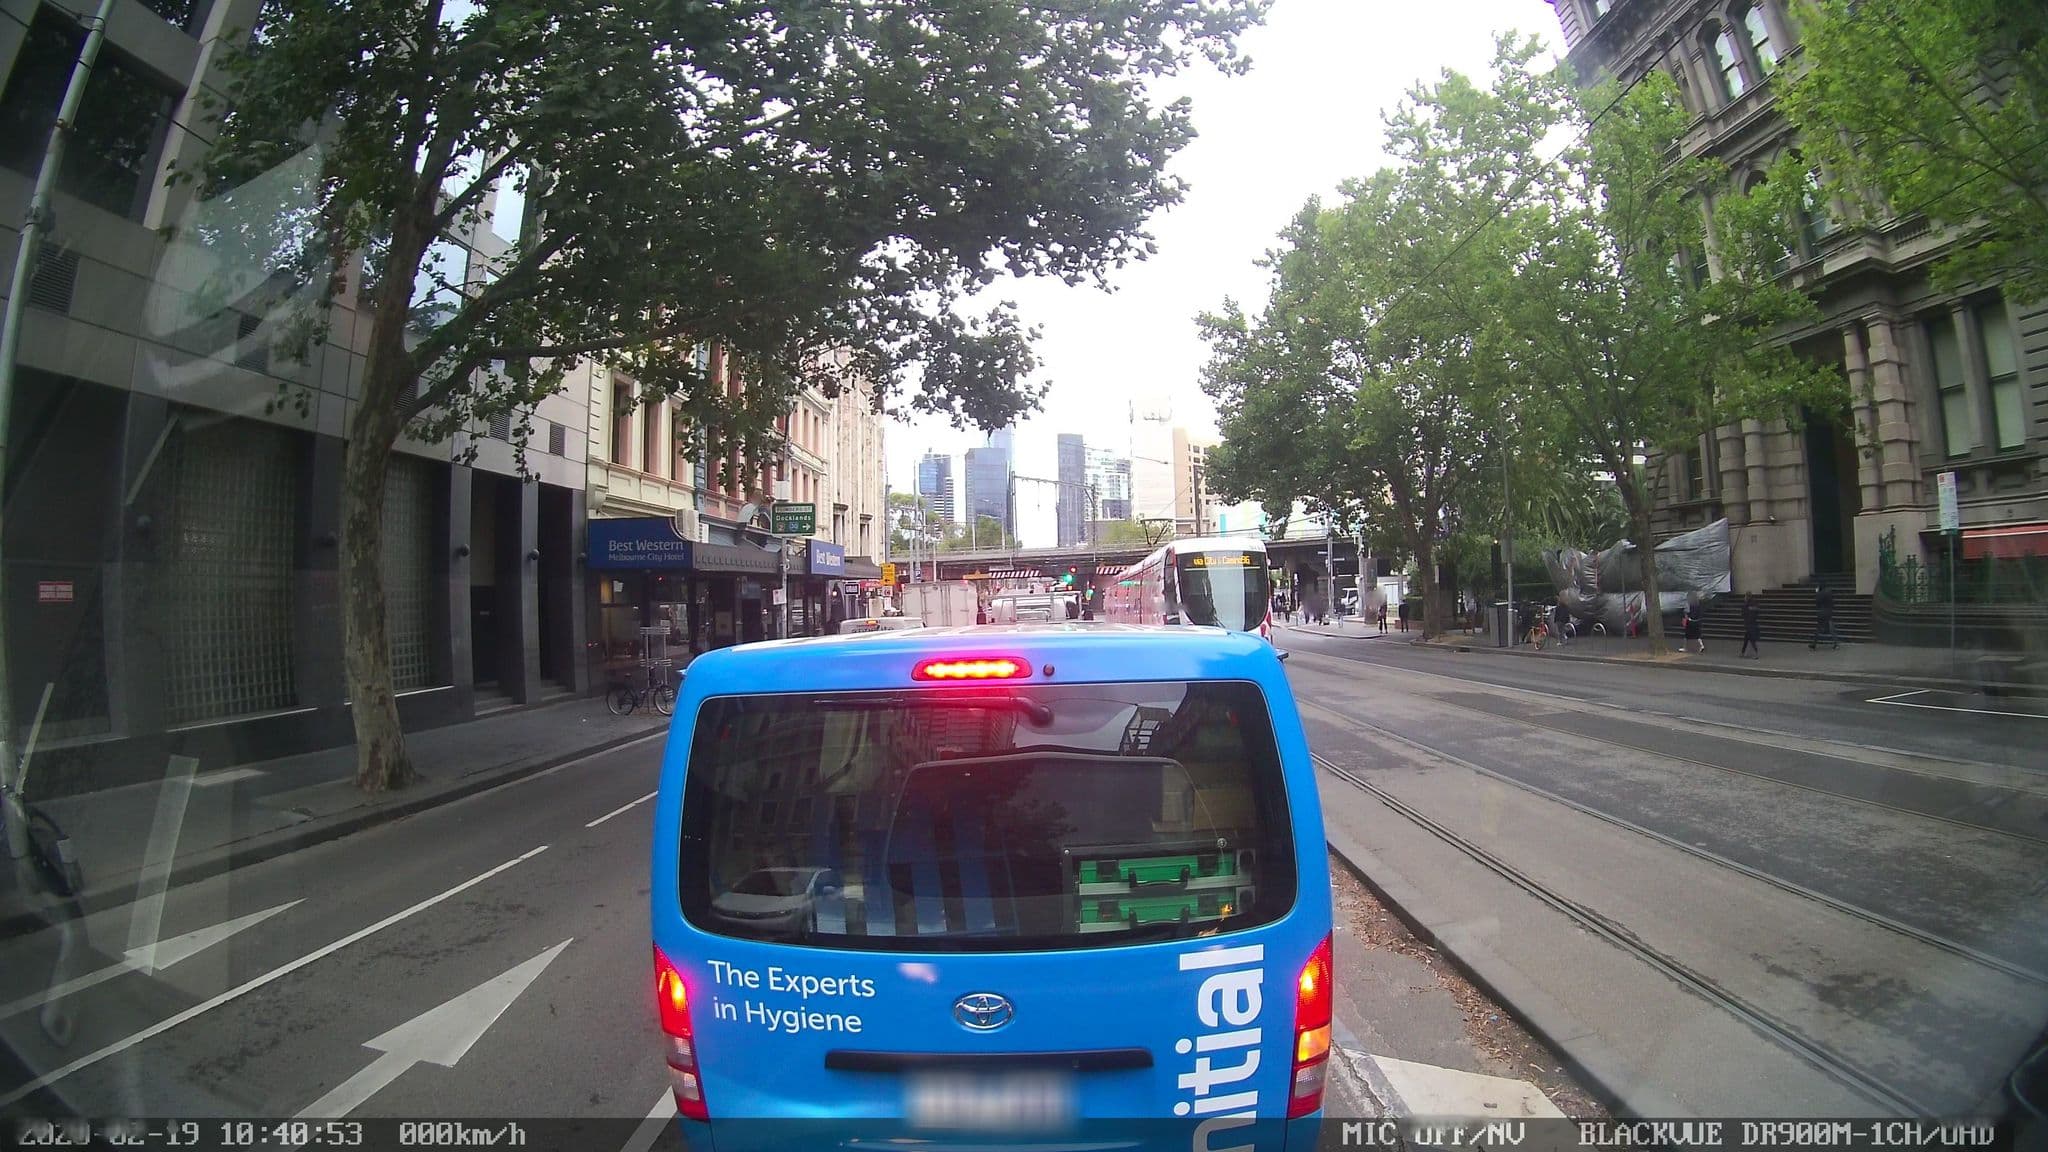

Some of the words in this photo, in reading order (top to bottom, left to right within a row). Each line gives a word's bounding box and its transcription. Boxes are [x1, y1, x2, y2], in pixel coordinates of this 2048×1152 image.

[609, 540, 633, 551] Best
[636, 540, 684, 551] Western
[609, 553, 646, 561] Melbourne
[647, 553, 663, 562] City
[664, 553, 684, 561] Hotel
[816, 549, 826, 565] Best
[707, 960, 760, 988] The
[768, 967, 876, 999] Experts
[713, 996, 737, 1021] in
[745, 1000, 862, 1033] Hygiene
